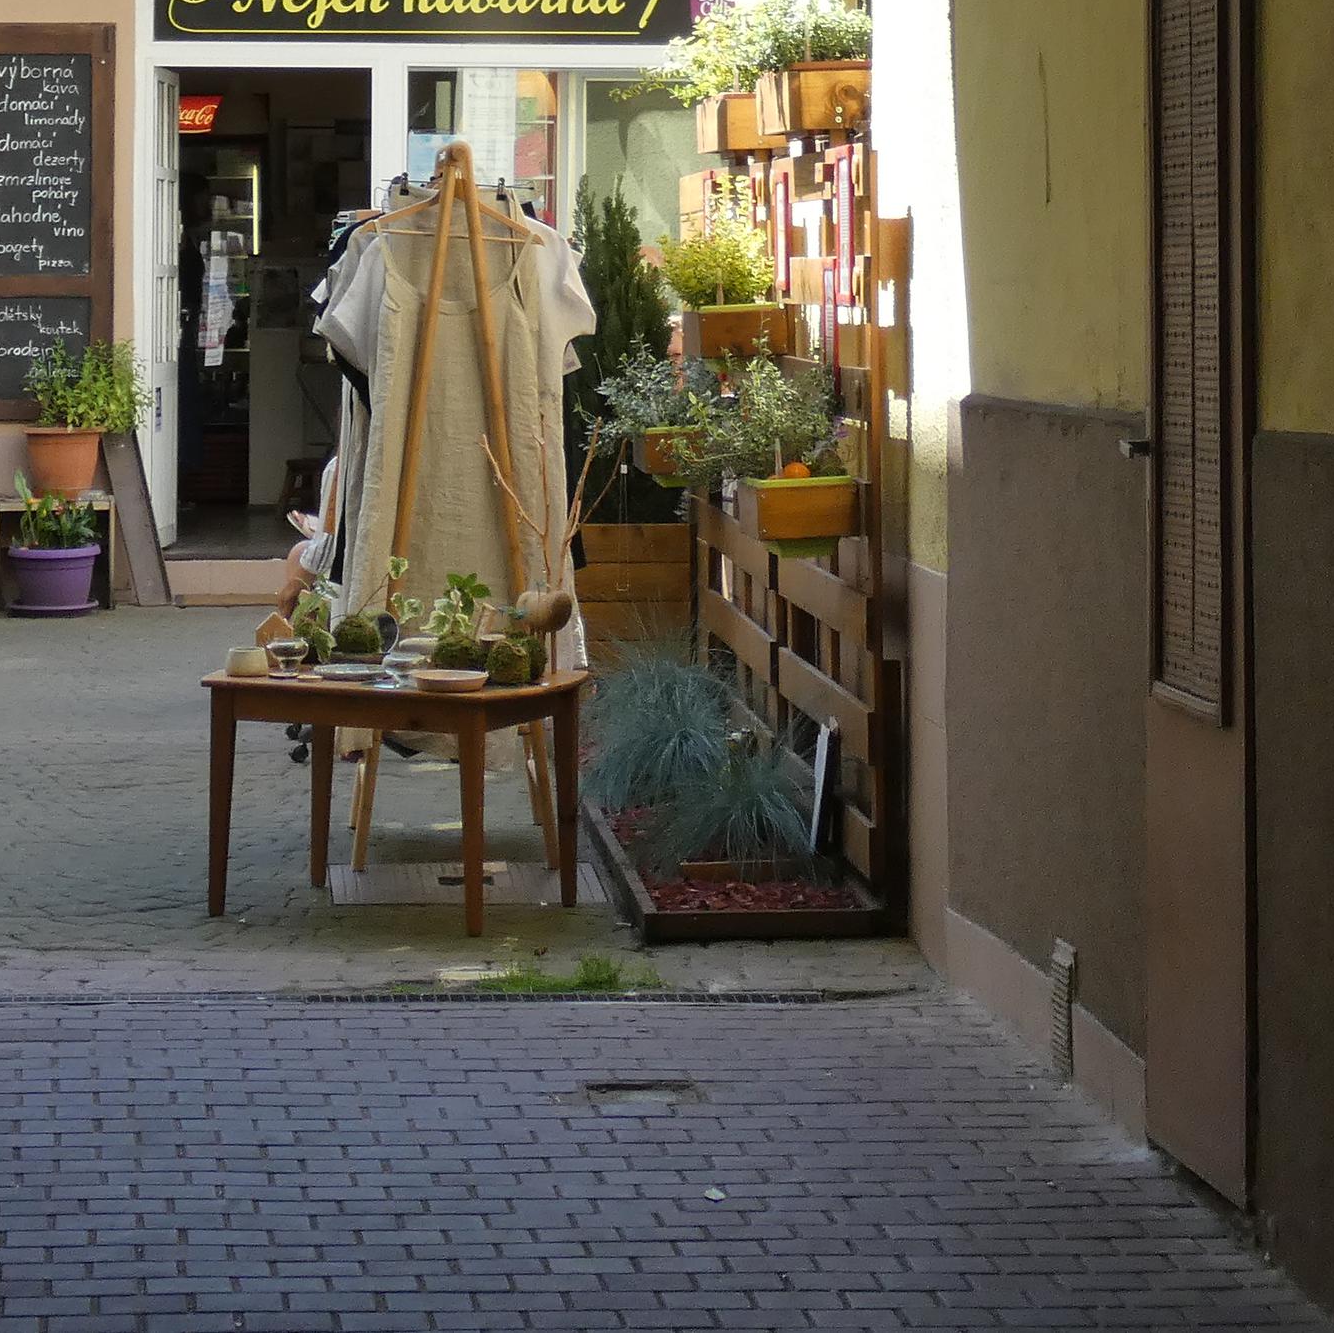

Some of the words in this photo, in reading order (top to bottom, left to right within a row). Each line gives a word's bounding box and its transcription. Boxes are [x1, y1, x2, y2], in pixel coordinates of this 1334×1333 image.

[42, 77, 80, 95] káva
[24, 104, 86, 134] limonády
[32, 149, 85, 174] dezerty
[31, 185, 79, 207] poháry
[53, 219, 85, 237] víno
[38, 259, 74, 272] pizza
[39, 320, 84, 336] koutek
